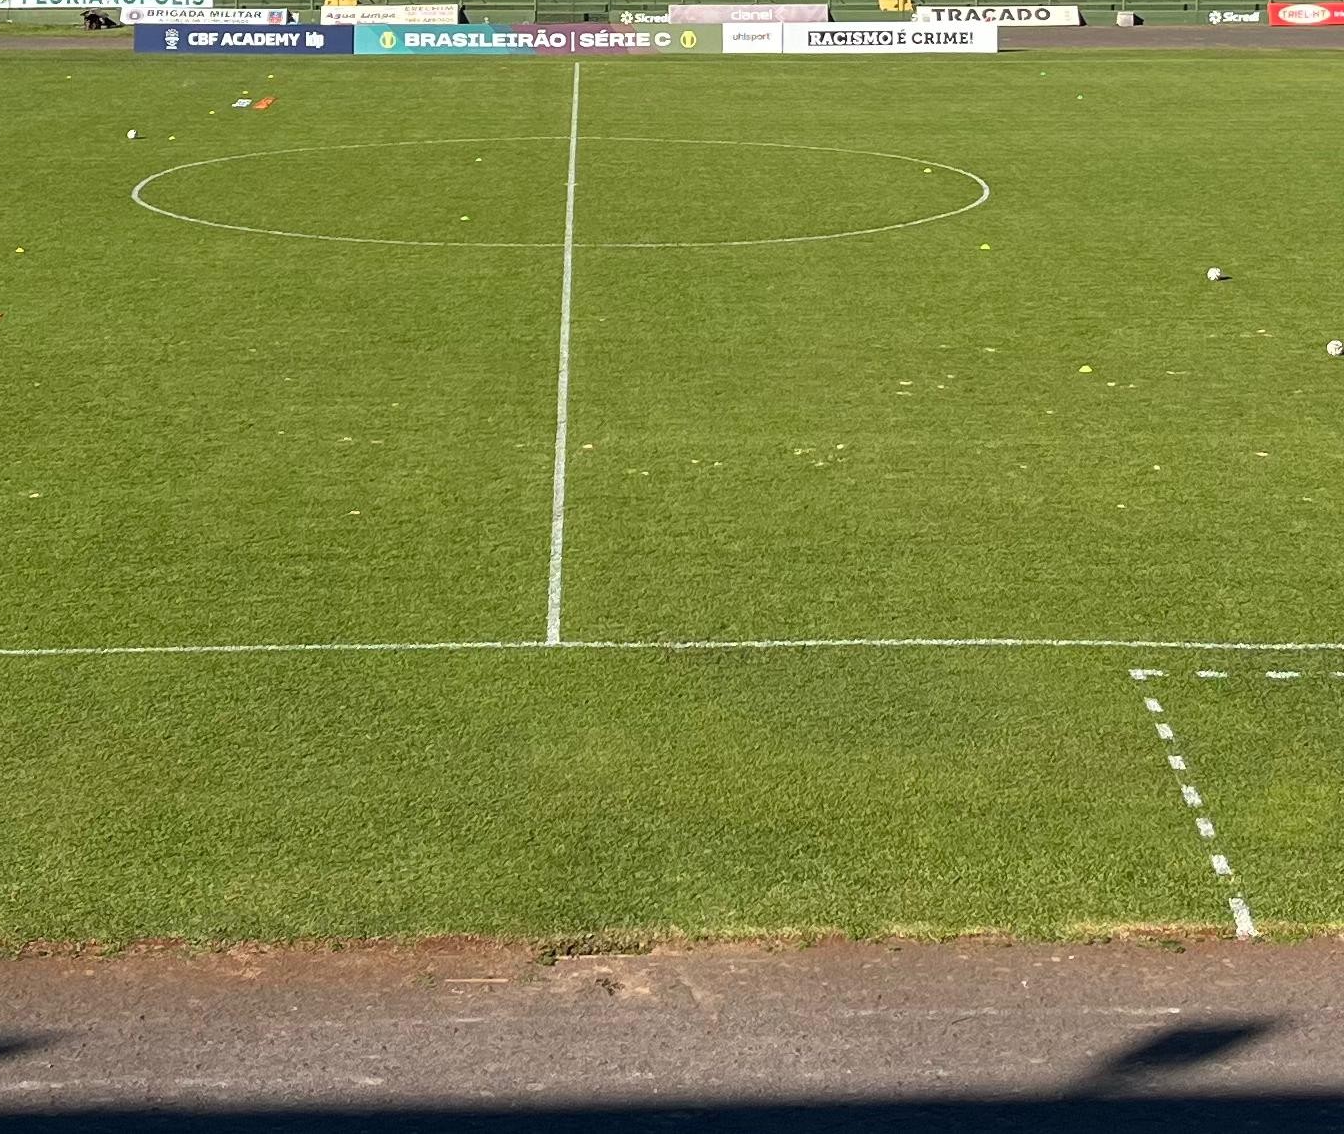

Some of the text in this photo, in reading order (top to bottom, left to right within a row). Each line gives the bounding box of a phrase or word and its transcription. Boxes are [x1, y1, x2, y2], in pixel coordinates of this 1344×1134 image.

[146, 9, 263, 20] BRIGADA MILITAR
[931, 8, 1051, 23] TRAÇADO
[1222, 11, 1260, 22] Sicredi
[187, 32, 219, 47] CBF
[220, 32, 301, 47] ACADEMY
[404, 27, 672, 48] BRASILEIRÃO SÉRIE C
[732, 32, 770, 41] uhlsport
[808, 29, 974, 46] RACISMO É CRIME!
